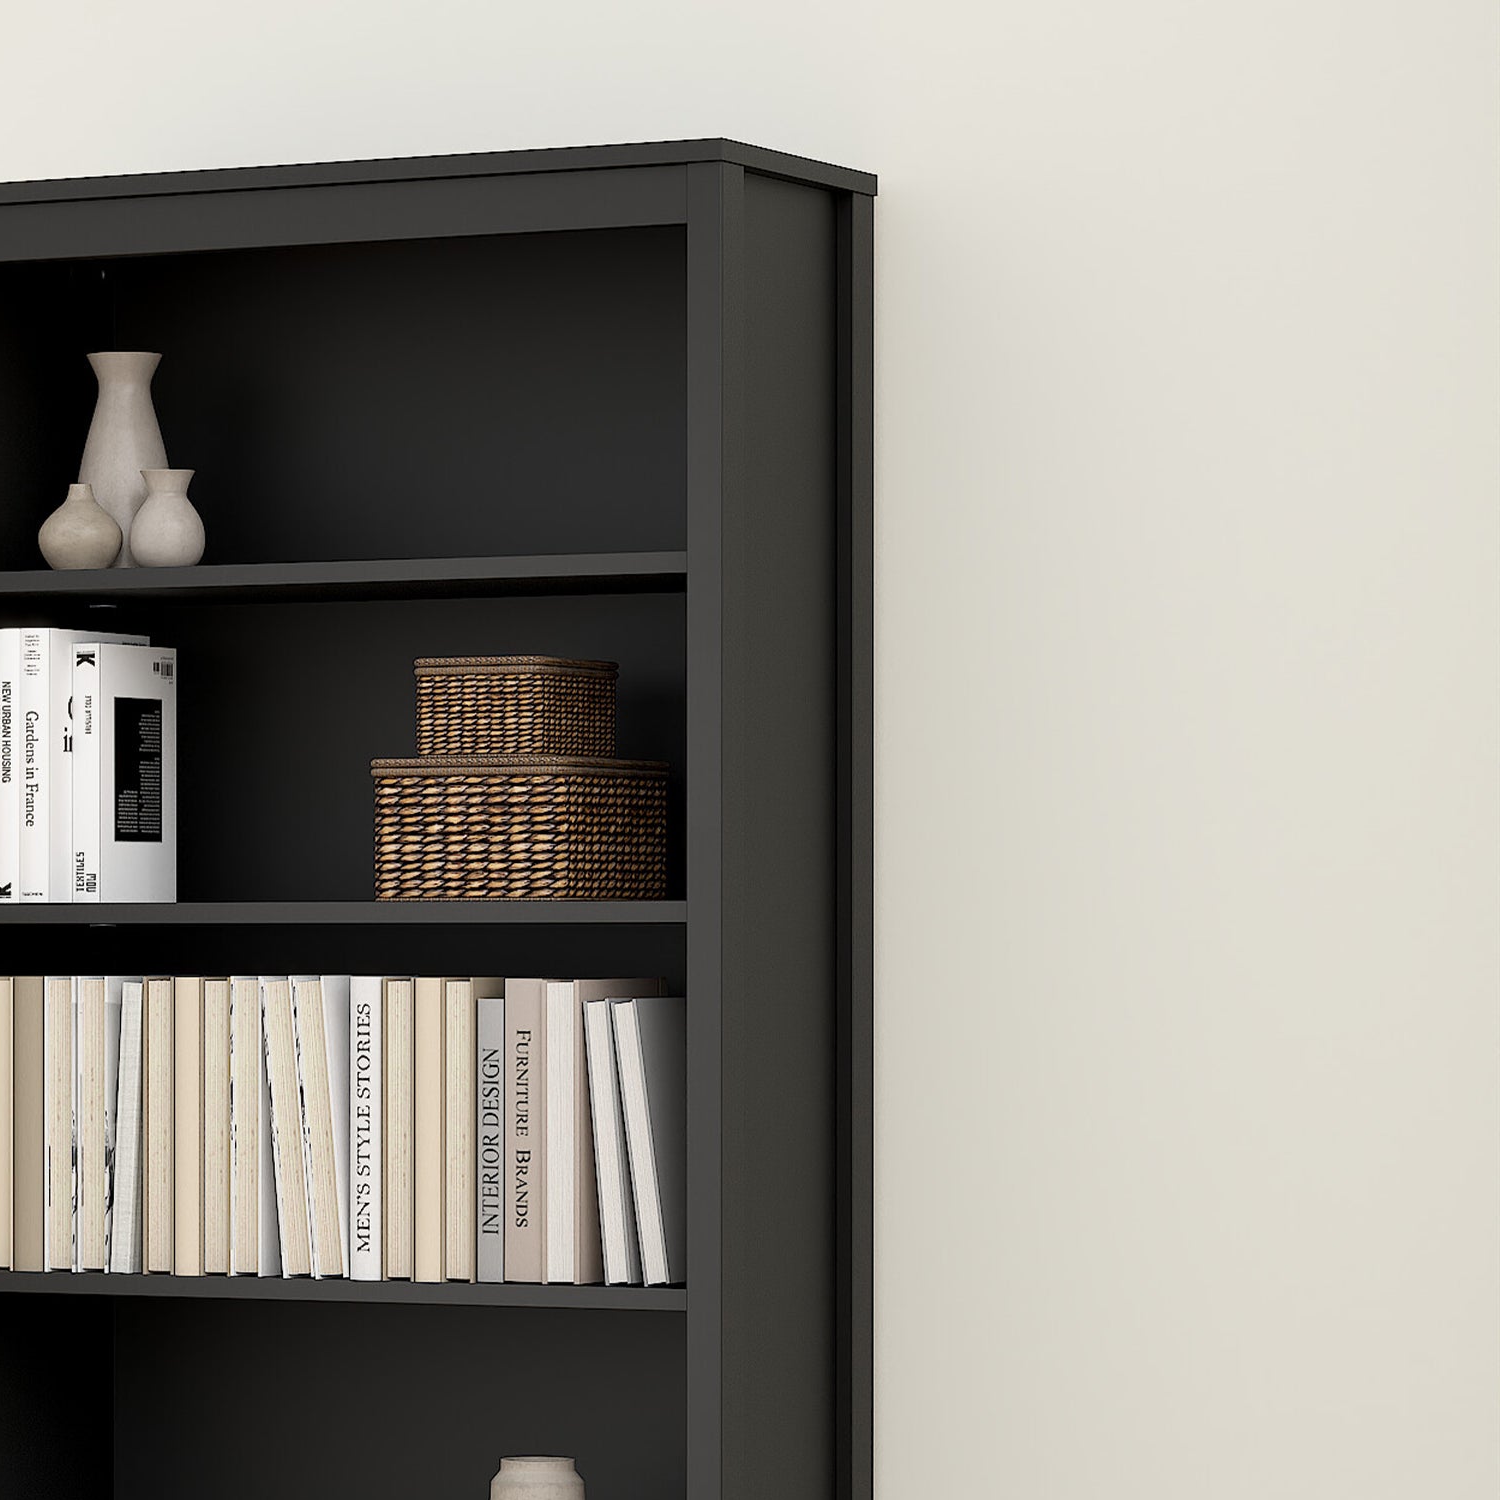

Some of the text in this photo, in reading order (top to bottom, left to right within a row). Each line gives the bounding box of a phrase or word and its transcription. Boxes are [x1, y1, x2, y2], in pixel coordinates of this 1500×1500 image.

[2, 682, 11, 783] NEW URBAN HOUSING
[26, 711, 39, 826] Gardens in France
[76, 852, 84, 891] TEXTILES
[357, 1003, 371, 1099] STORIES
[357, 1105, 370, 1176] STYLE
[482, 1049, 499, 1234] INTERIOR DESIGN
